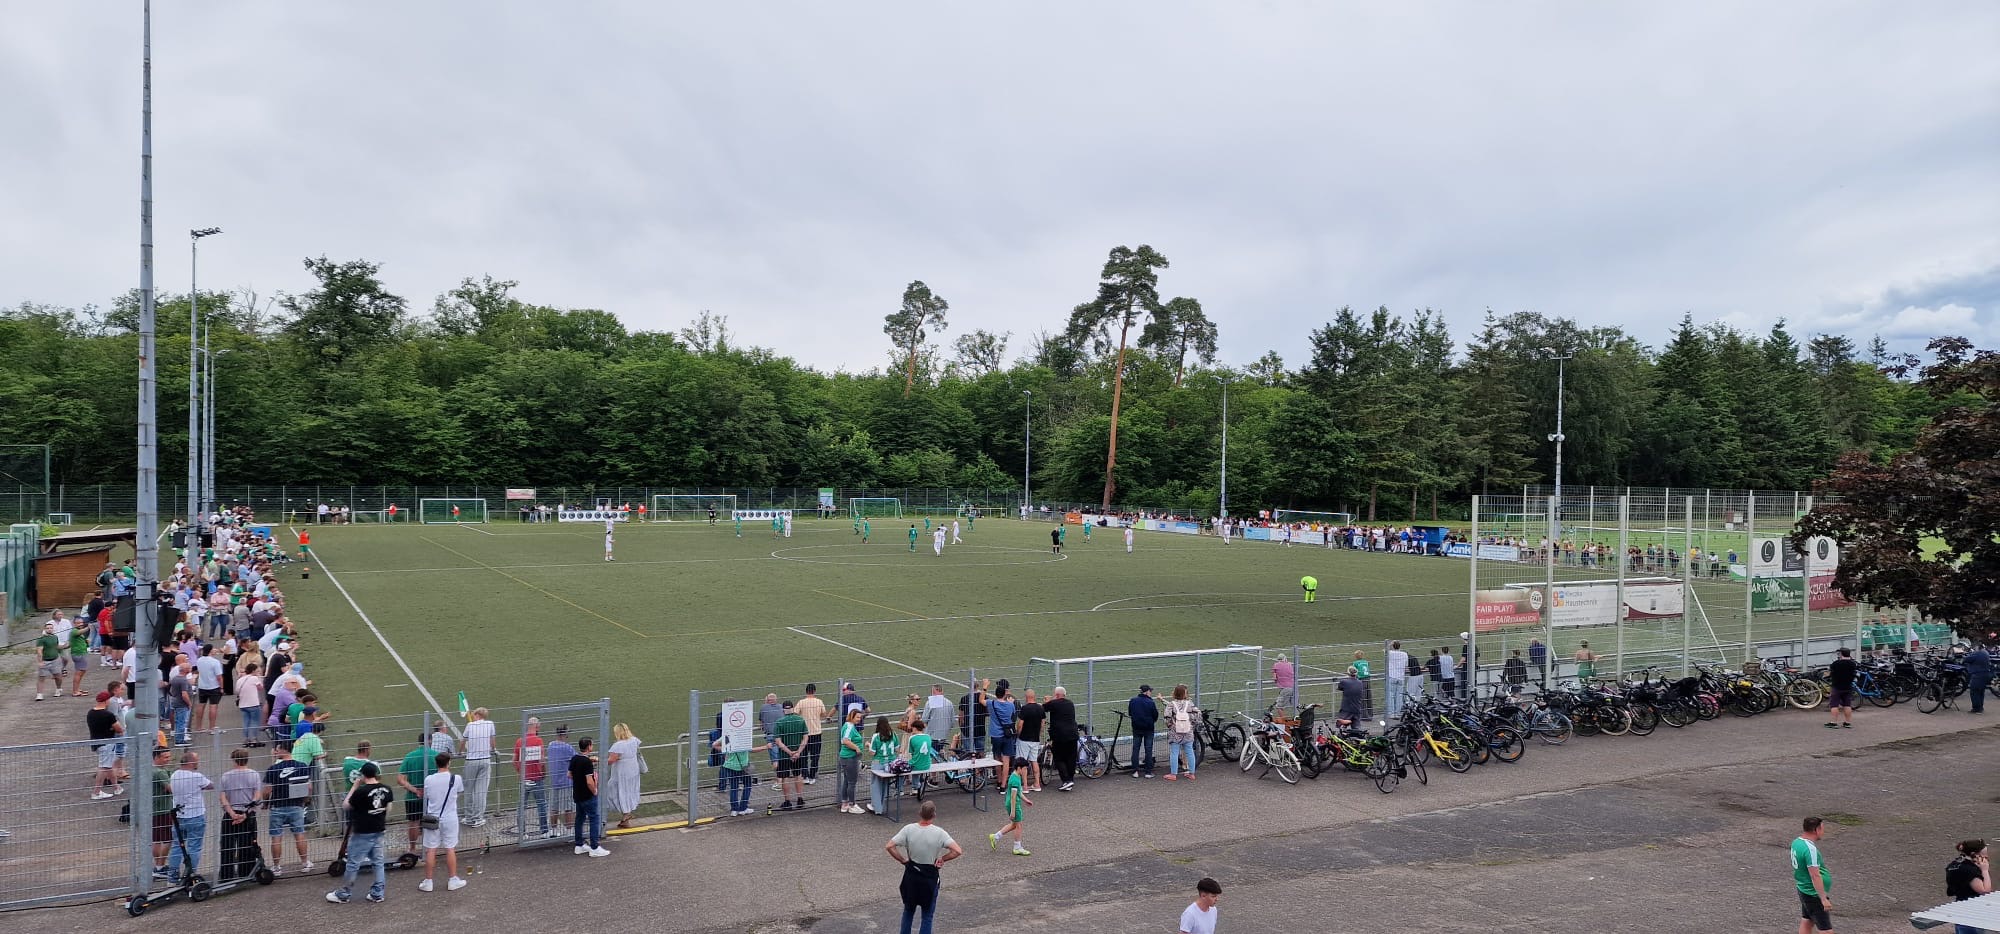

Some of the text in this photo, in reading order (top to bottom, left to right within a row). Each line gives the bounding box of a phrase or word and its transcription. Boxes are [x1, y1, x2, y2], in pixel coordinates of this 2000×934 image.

[1476, 604, 1513, 613] FAIR PLAY?
[881, 741, 895, 756] 11
[920, 741, 929, 756] 4
